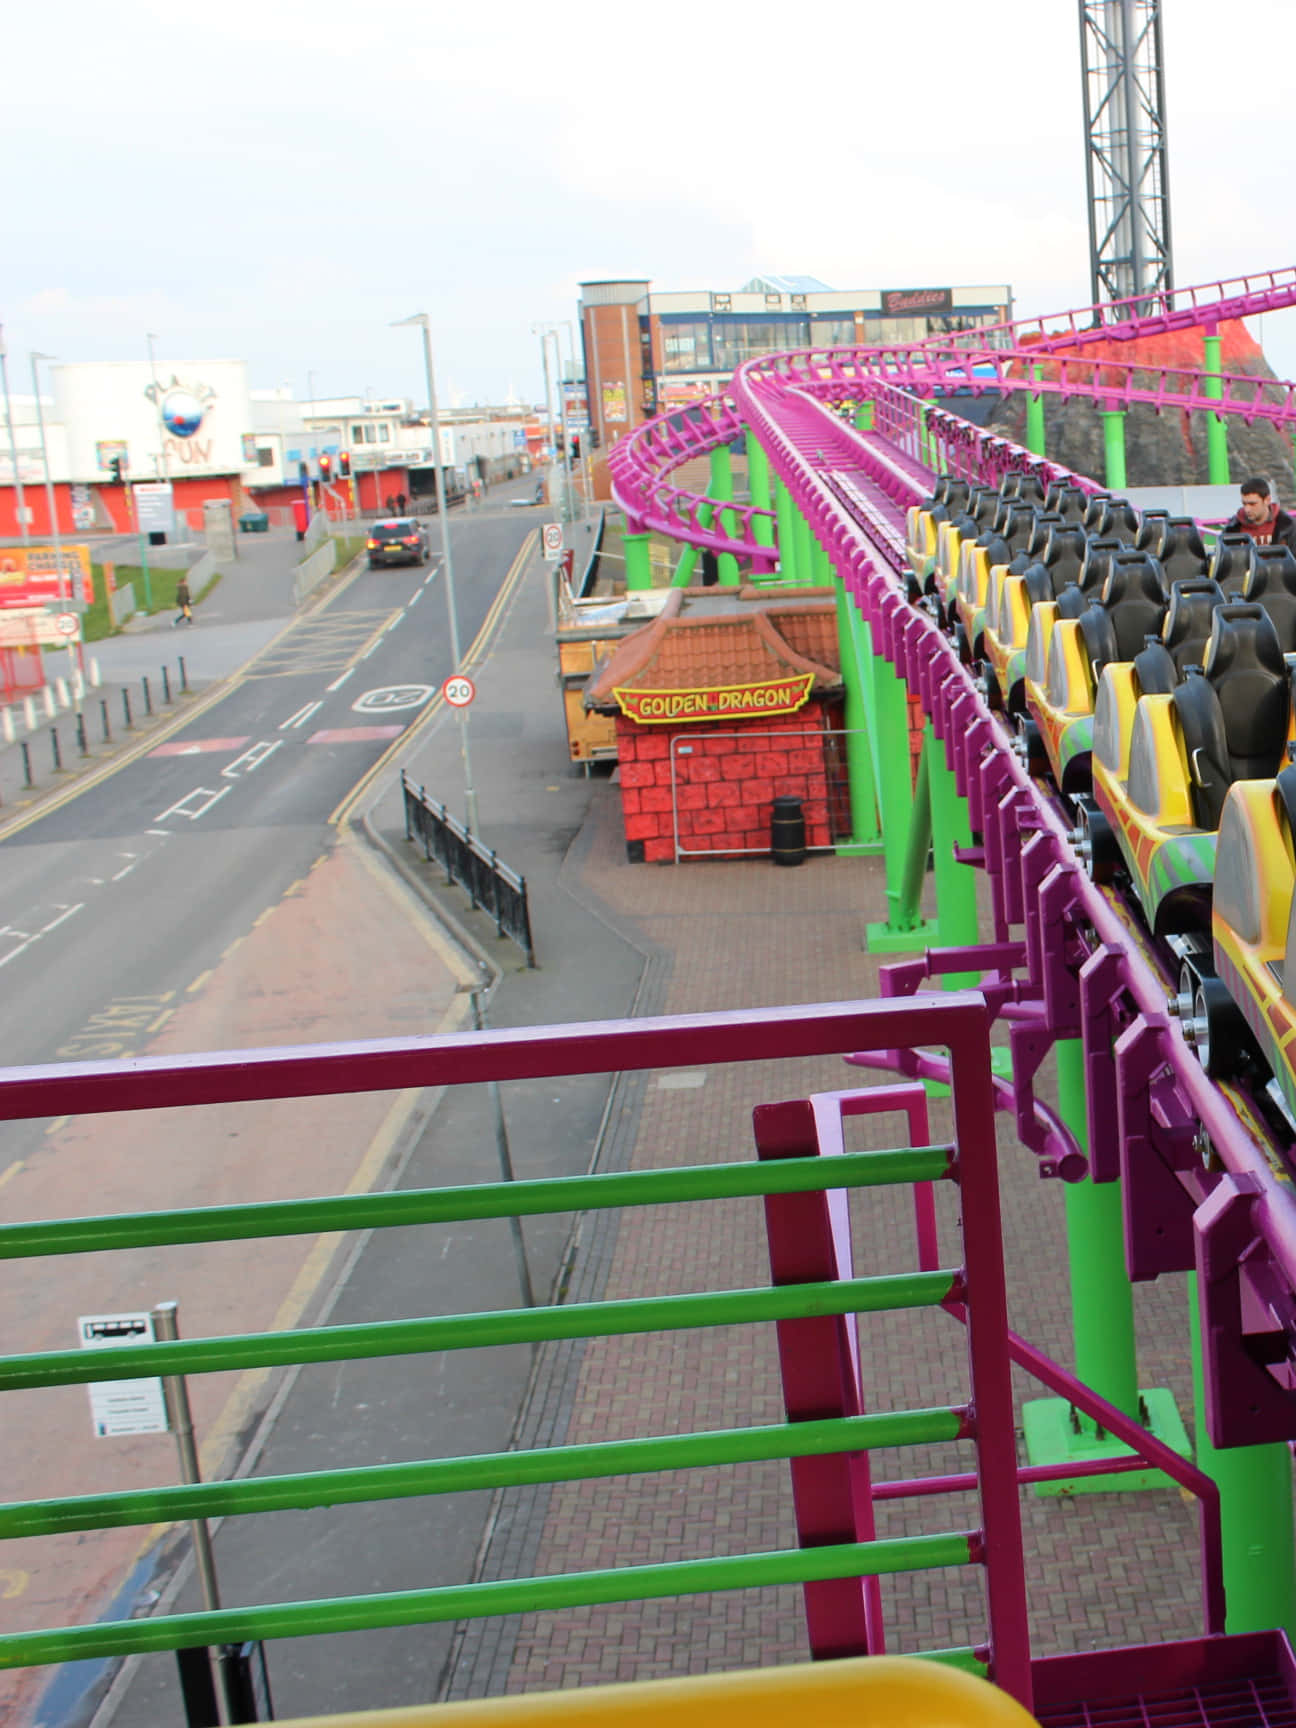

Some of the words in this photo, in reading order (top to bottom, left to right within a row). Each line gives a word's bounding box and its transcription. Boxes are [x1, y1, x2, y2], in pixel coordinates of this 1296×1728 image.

[447, 684, 470, 698] 20
[639, 694, 709, 718] GOLDEN
[718, 687, 791, 711] DRAGON
